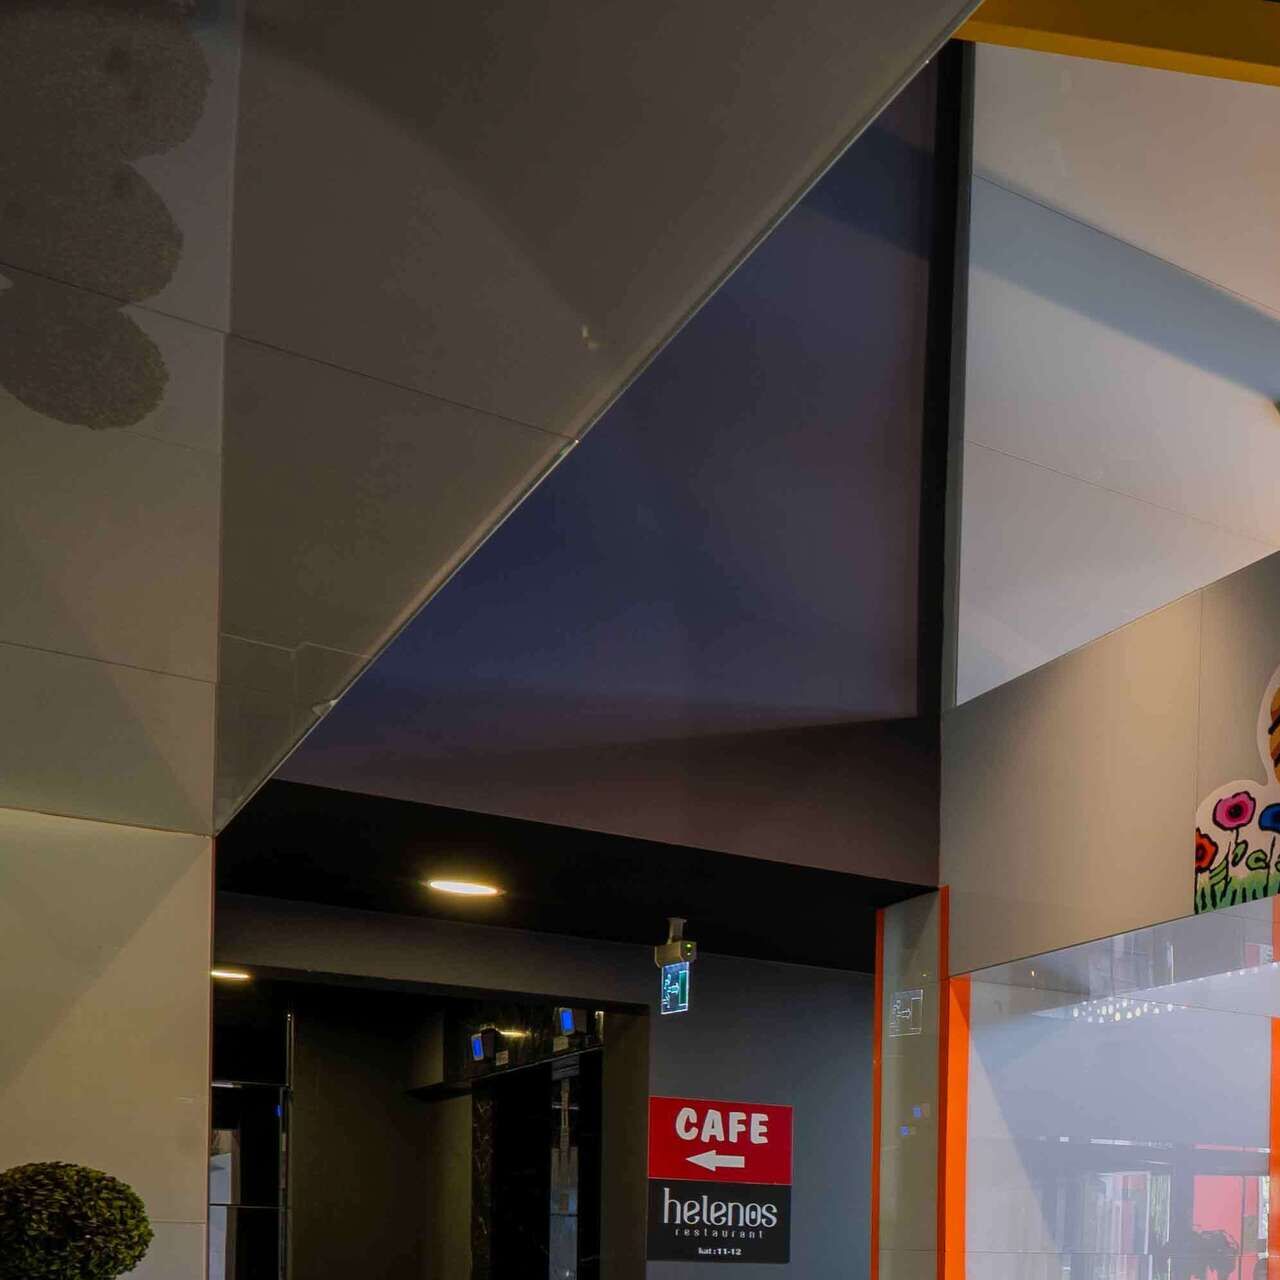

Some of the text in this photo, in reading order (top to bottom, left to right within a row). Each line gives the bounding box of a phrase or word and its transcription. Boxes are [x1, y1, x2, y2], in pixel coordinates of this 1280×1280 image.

[675, 1107, 769, 1144] CAFE
[663, 1187, 778, 1228] helenos
[675, 1228, 763, 1239] restaurant
